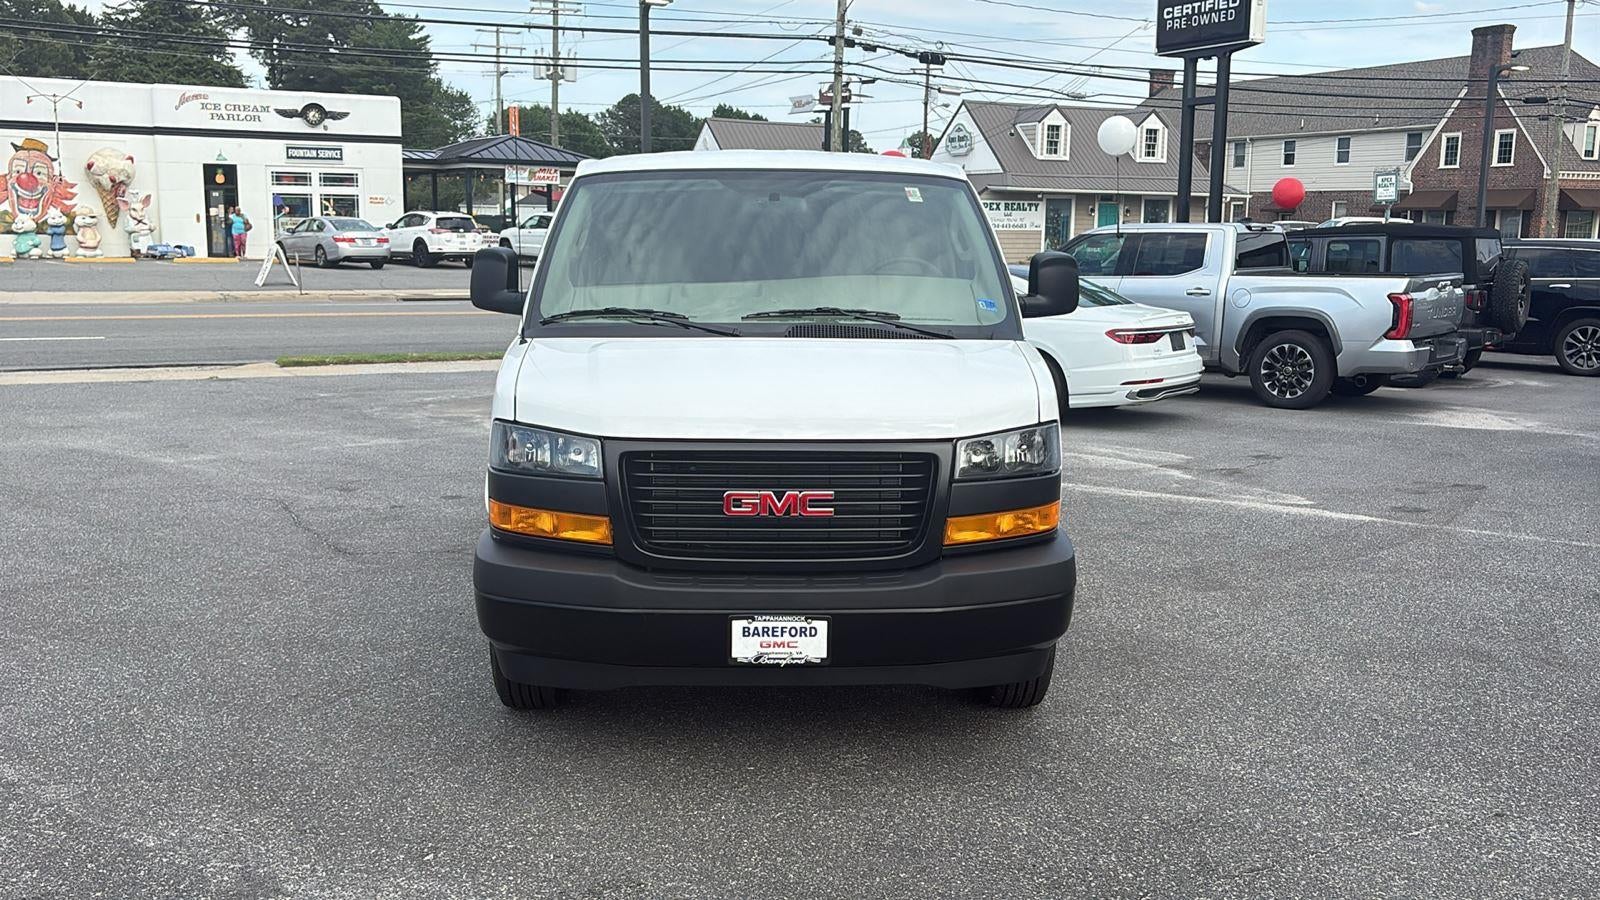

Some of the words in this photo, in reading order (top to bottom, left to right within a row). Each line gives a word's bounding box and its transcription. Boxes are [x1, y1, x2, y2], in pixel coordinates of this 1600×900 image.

[1163, 0, 1240, 19] CERTIFIED
[1166, 9, 1236, 31] PRE-OWNED
[200, 102, 222, 111] ICE
[224, 103, 272, 113] CREAM
[209, 112, 262, 122] PARLOR
[287, 148, 317, 158] FOUNTAIN
[317, 149, 342, 159] SERVICE
[538, 167, 559, 175] MILK
[982, 202, 1001, 212] PEX
[1003, 202, 1040, 212] REALTY
[723, 490, 835, 517] GMC
[742, 626, 818, 638] BAREFORD
[759, 640, 799, 649] GMC
[751, 654, 809, 668] Bareford
